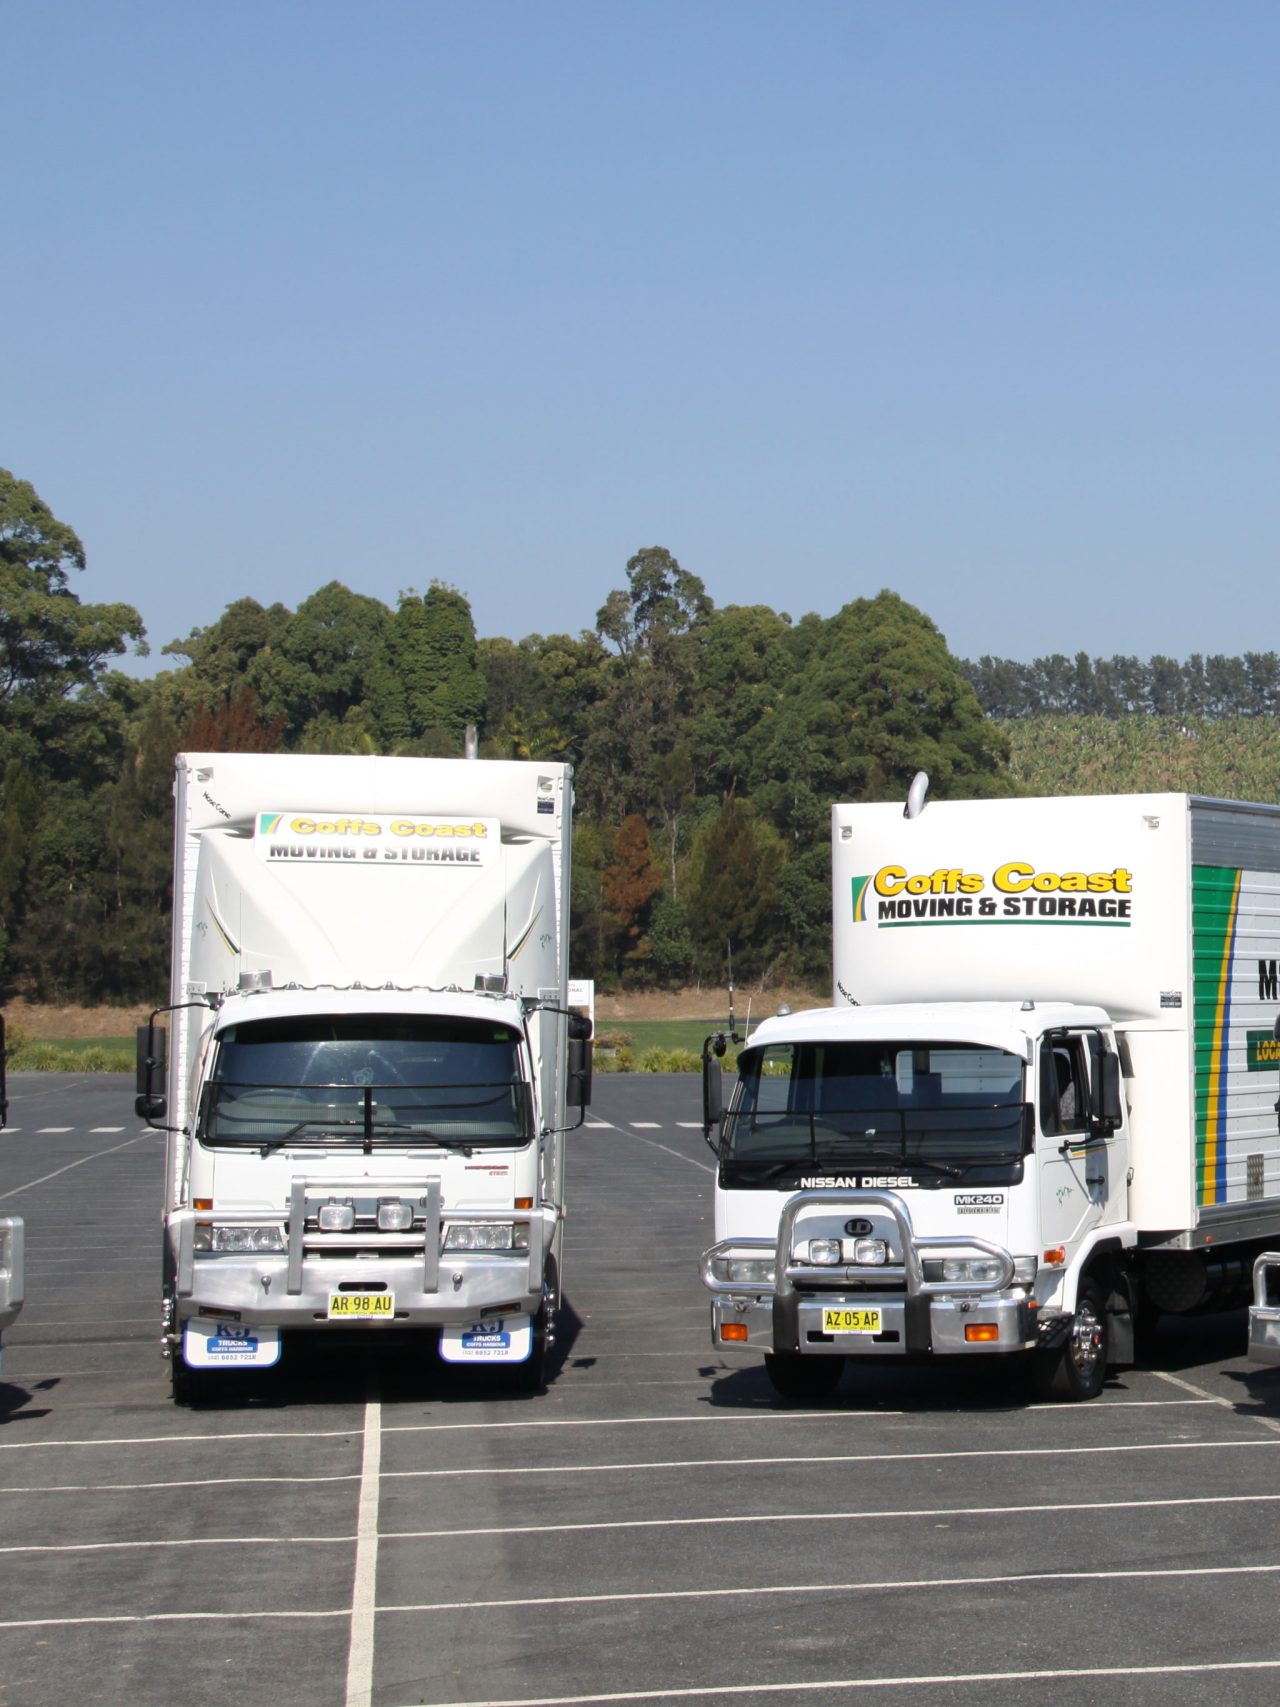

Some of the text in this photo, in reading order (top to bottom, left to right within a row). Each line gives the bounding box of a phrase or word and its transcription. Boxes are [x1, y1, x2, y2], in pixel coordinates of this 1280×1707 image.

[291, 817, 487, 839] Coffs Coast
[270, 843, 480, 862] MOVING & STORAGE
[873, 862, 1132, 897] Coffs Coast
[878, 897, 1131, 919] MOVING & STORAGE
[801, 1176, 919, 1188] NISSAN DIESEL
[956, 1195, 1003, 1204] MK240
[332, 1297, 391, 1310] AR 98 AU
[826, 1312, 878, 1325] AZ 05 AP
